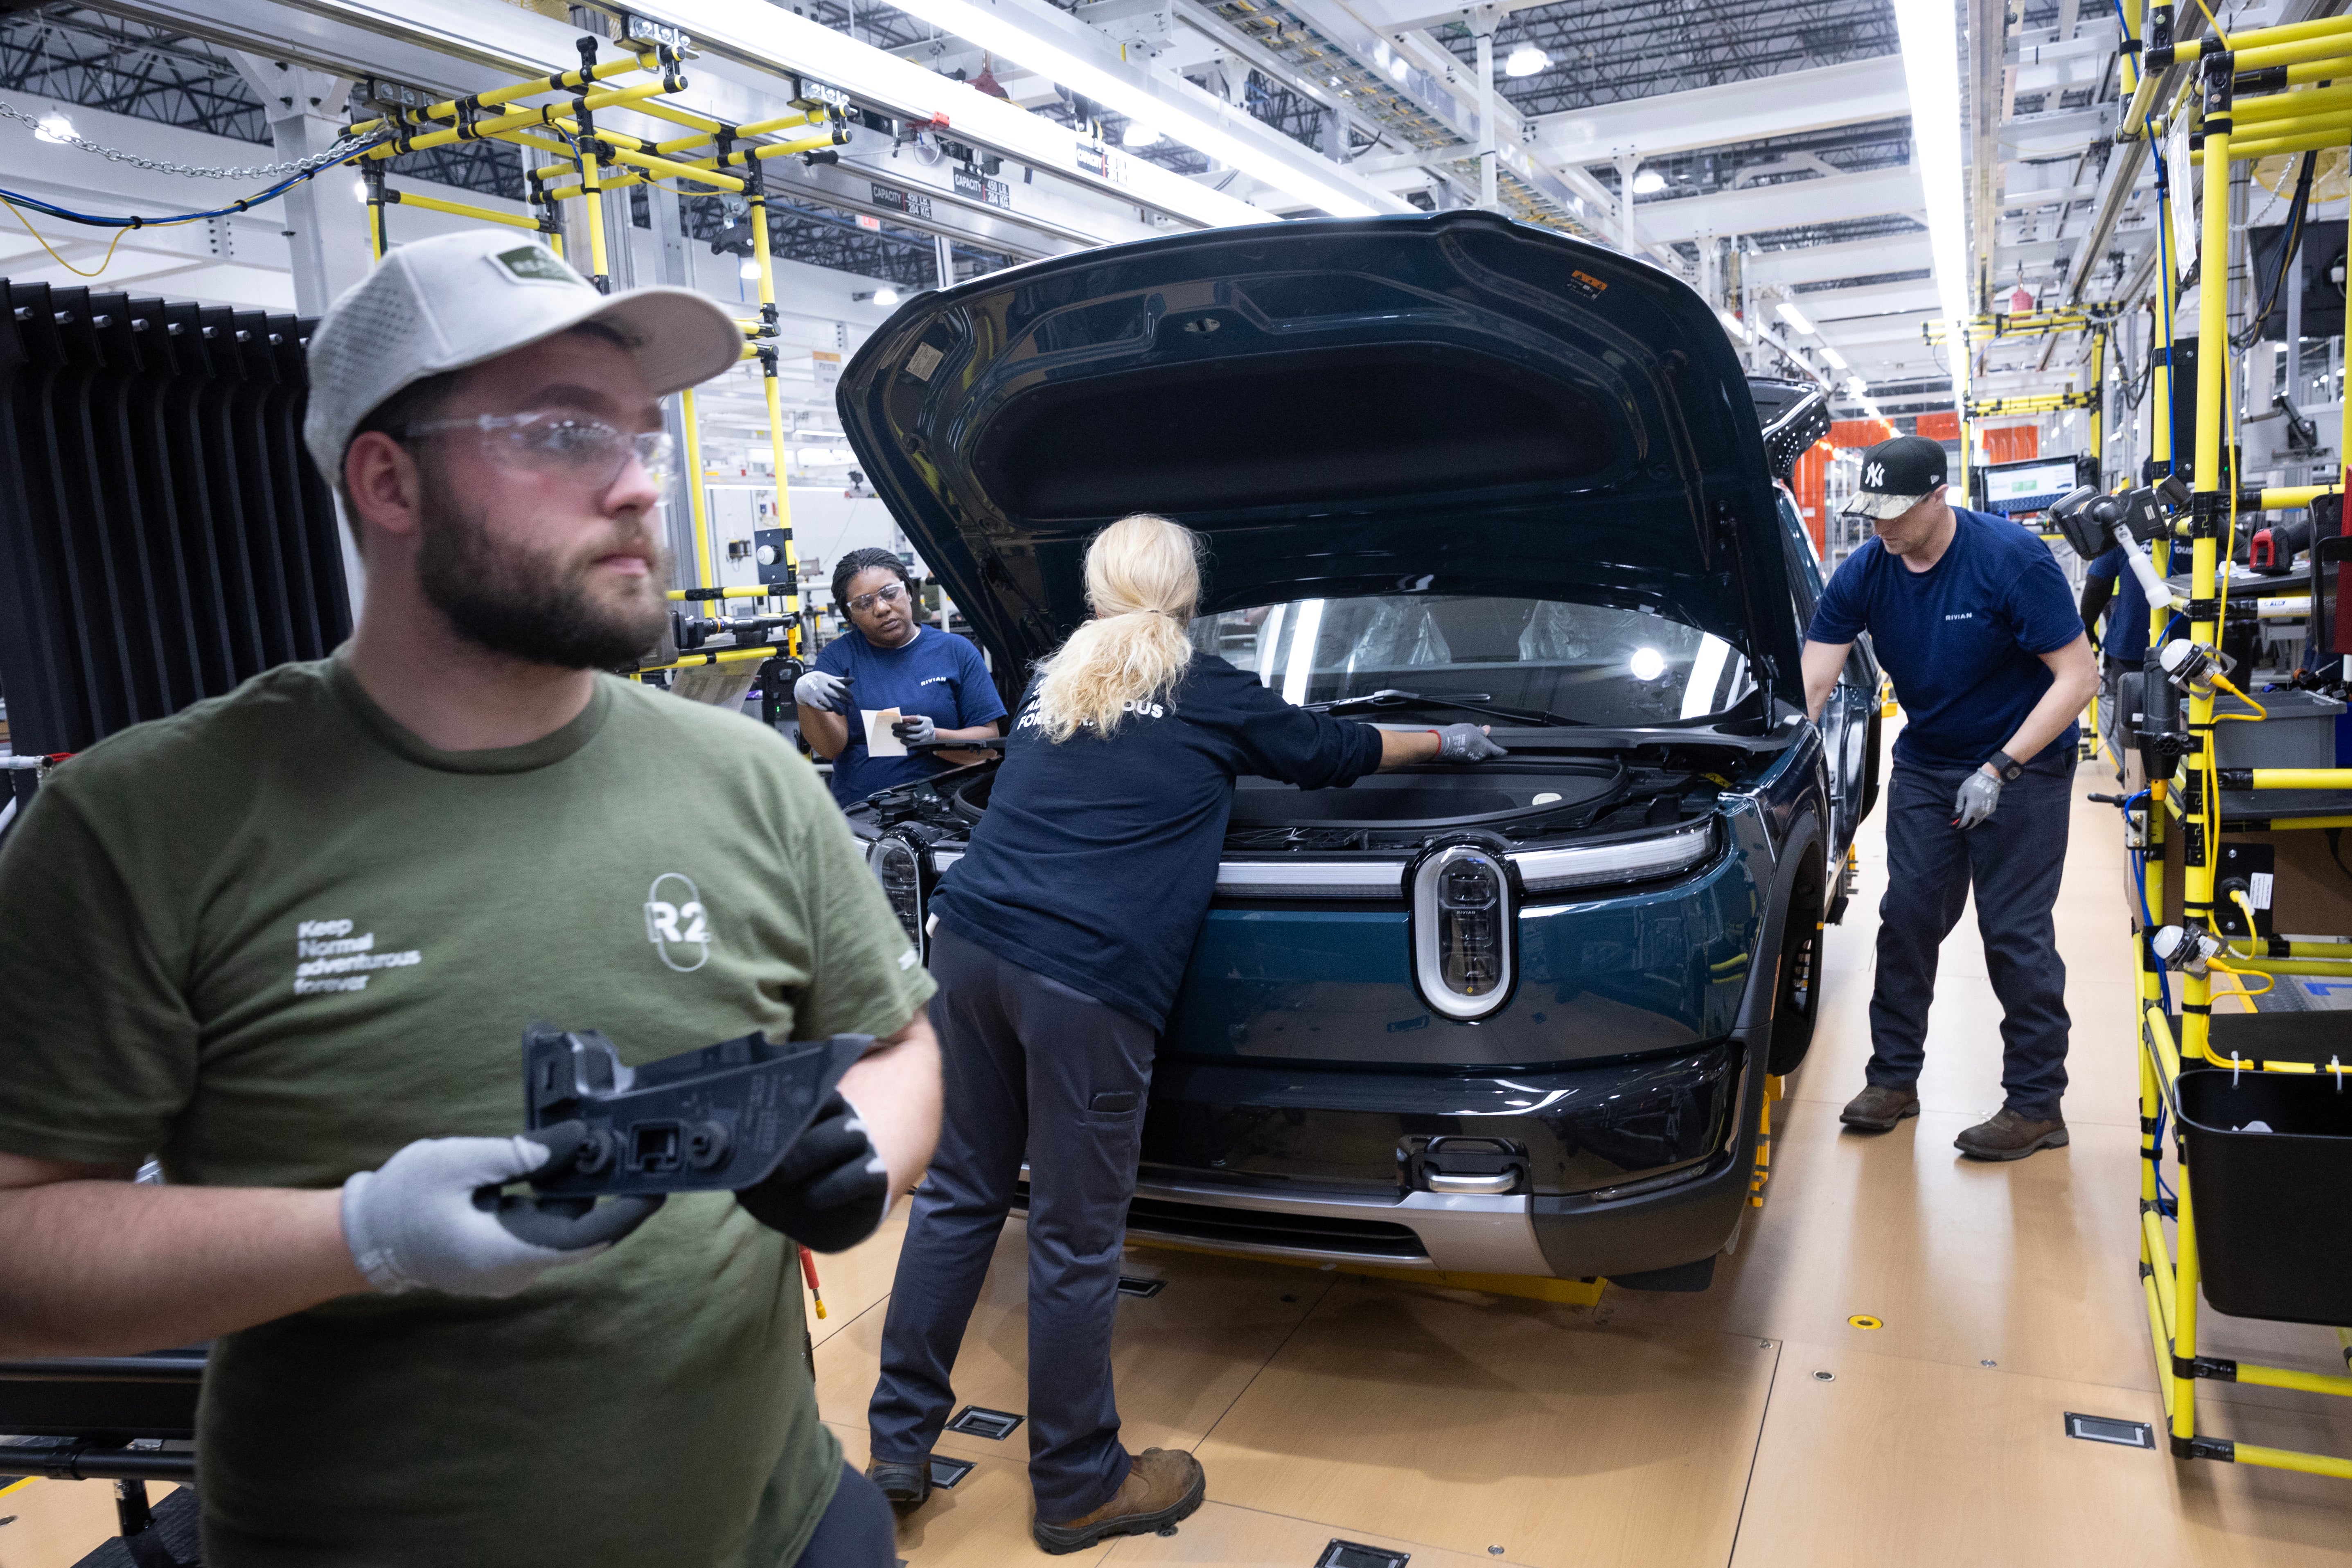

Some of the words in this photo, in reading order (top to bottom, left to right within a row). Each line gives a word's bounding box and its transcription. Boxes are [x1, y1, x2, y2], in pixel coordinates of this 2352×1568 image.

[955, 174, 981, 192] CAPACITY
[988, 180, 997, 192] 450
[873, 186, 901, 203] CAPACITY
[988, 192, 998, 204] 204
[1865, 461, 1885, 487] NY
[1945, 612, 1972, 621] RIVIAN
[920, 676, 946, 686] RIVIAN
[1017, 711, 1094, 731] FORER.
[297, 919, 354, 939] Keep
[644, 901, 711, 943] R2
[298, 932, 374, 959] Normal
[295, 950, 422, 977] adventurous
